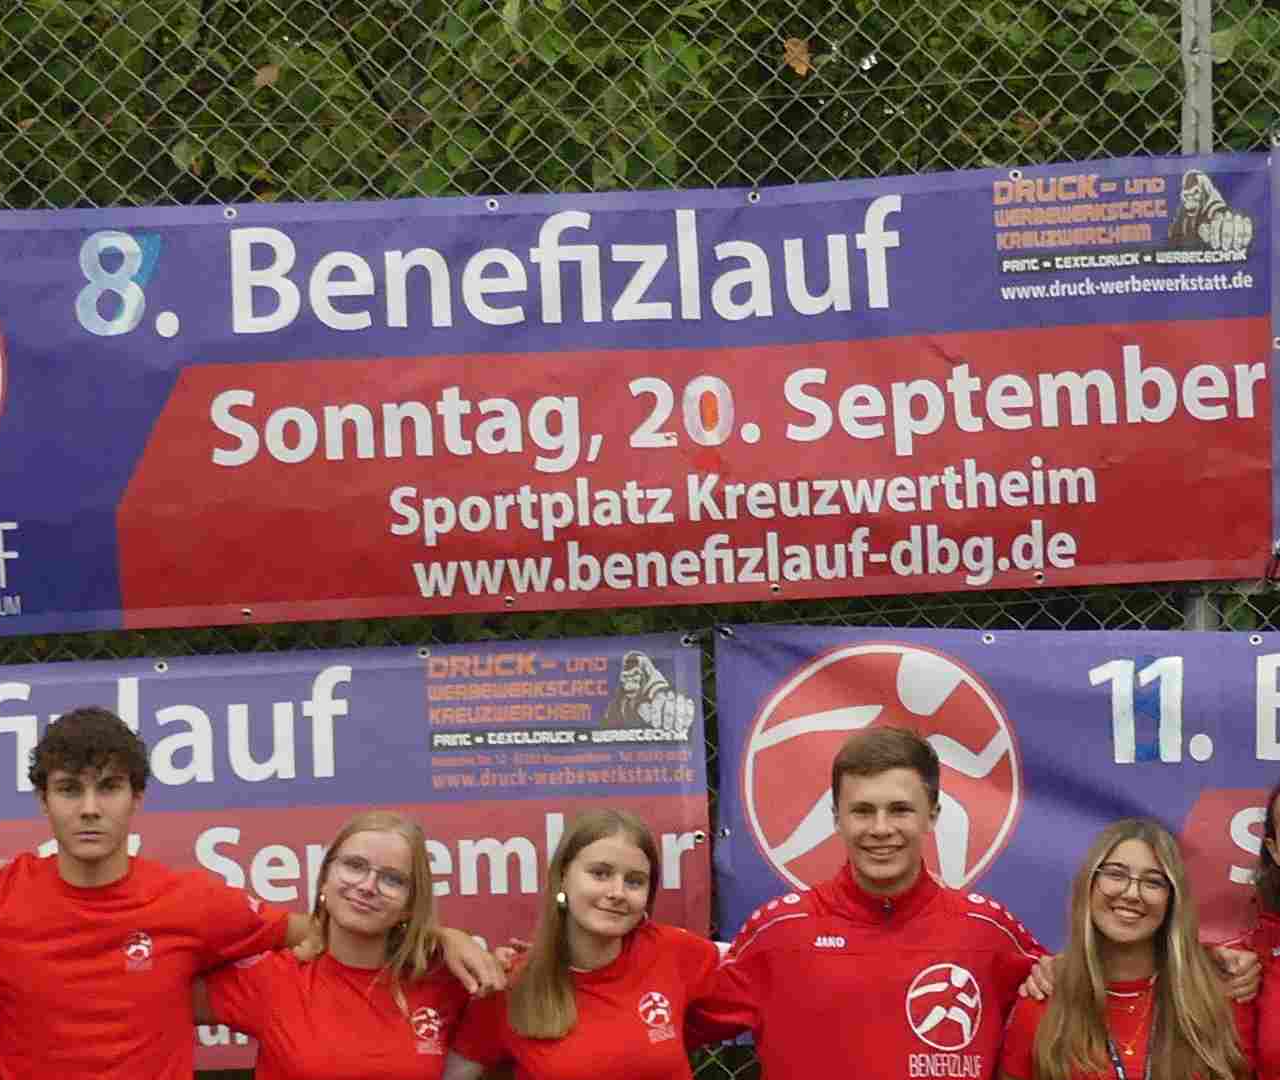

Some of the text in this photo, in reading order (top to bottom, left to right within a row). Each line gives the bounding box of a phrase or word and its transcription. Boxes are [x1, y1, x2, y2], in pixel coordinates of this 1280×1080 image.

[75, 195, 903, 339] 8. Benefizlauf
[1001, 271, 1253, 300] www.druck-werbewerkstatt.de
[210, 345, 1266, 473] Sonntag, 20. September
[391, 456, 1097, 546] Sportplatz Kreuzwertheim
[412, 520, 1077, 598] www.benefizlauf-dbg.de
[1088, 655, 1213, 763] 11.
